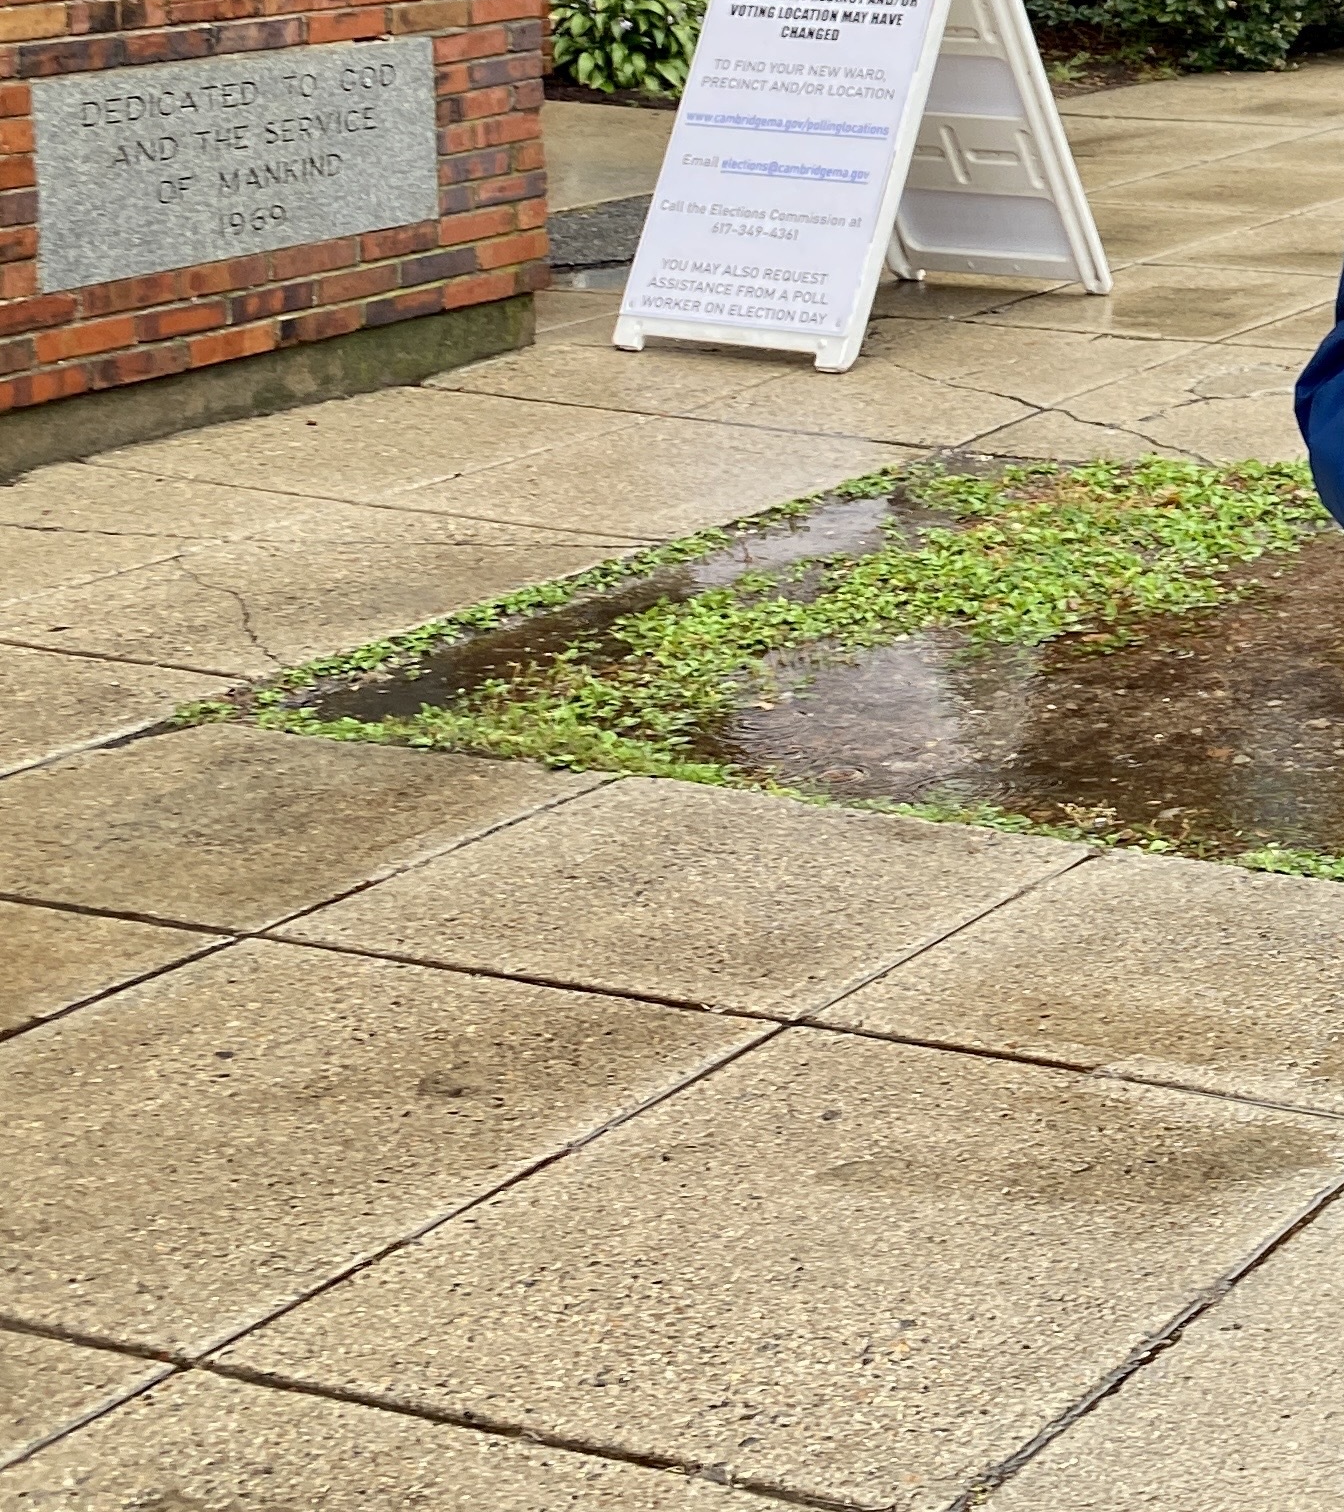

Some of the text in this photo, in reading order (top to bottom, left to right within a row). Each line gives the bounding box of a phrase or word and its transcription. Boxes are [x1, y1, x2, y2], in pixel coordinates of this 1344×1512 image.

[730, 4, 904, 26] VOTING LOCATION MAY HAVE
[781, 26, 840, 41] CHANGED
[714, 58, 887, 83] TO FIND YOUR NEW WARD,
[82, 63, 397, 128] DEDICATED TO GOD
[700, 76, 896, 101] PRECINCT AND/OR LOCATION
[112, 106, 378, 168] AND THE SERVICE
[681, 153, 720, 168] Email
[158, 152, 344, 205] OF MANKIND
[221, 204, 288, 236] 1969
[660, 199, 863, 228] Call the Elections Commission at
[711, 223, 799, 241] 617-349-4361
[661, 258, 829, 286] YOU MAY ALSO REQUEST
[647, 276, 829, 306] ASSISTANCE FROM A POLL
[641, 295, 828, 326] WORKER ON ELECTION DAY
